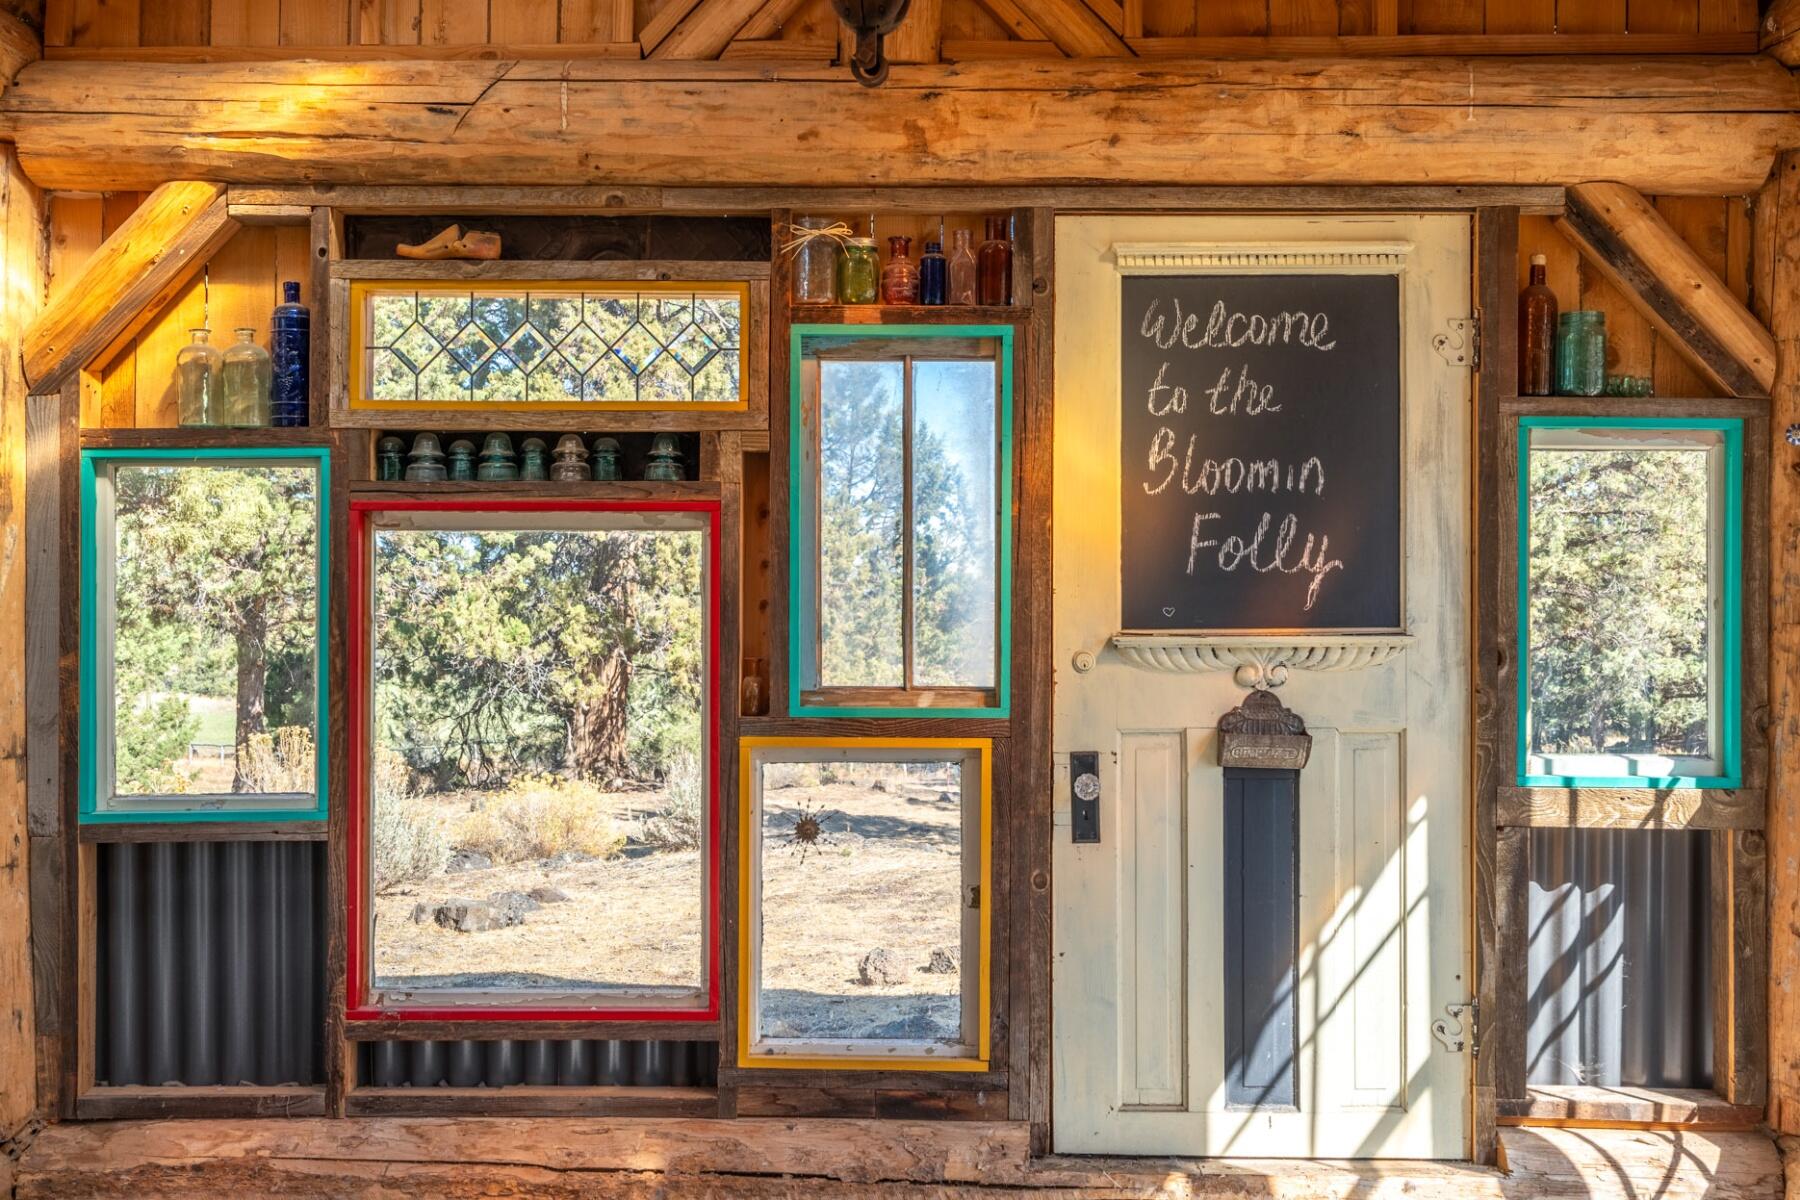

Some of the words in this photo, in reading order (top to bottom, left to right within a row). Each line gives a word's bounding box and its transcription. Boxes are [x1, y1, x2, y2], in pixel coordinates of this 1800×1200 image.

[1141, 298, 1336, 350] Welcome
[1147, 362, 1188, 416] to
[1205, 363, 1282, 416] the
[1143, 426, 1325, 495] Bloomin
[1186, 511, 1343, 611] Folly
